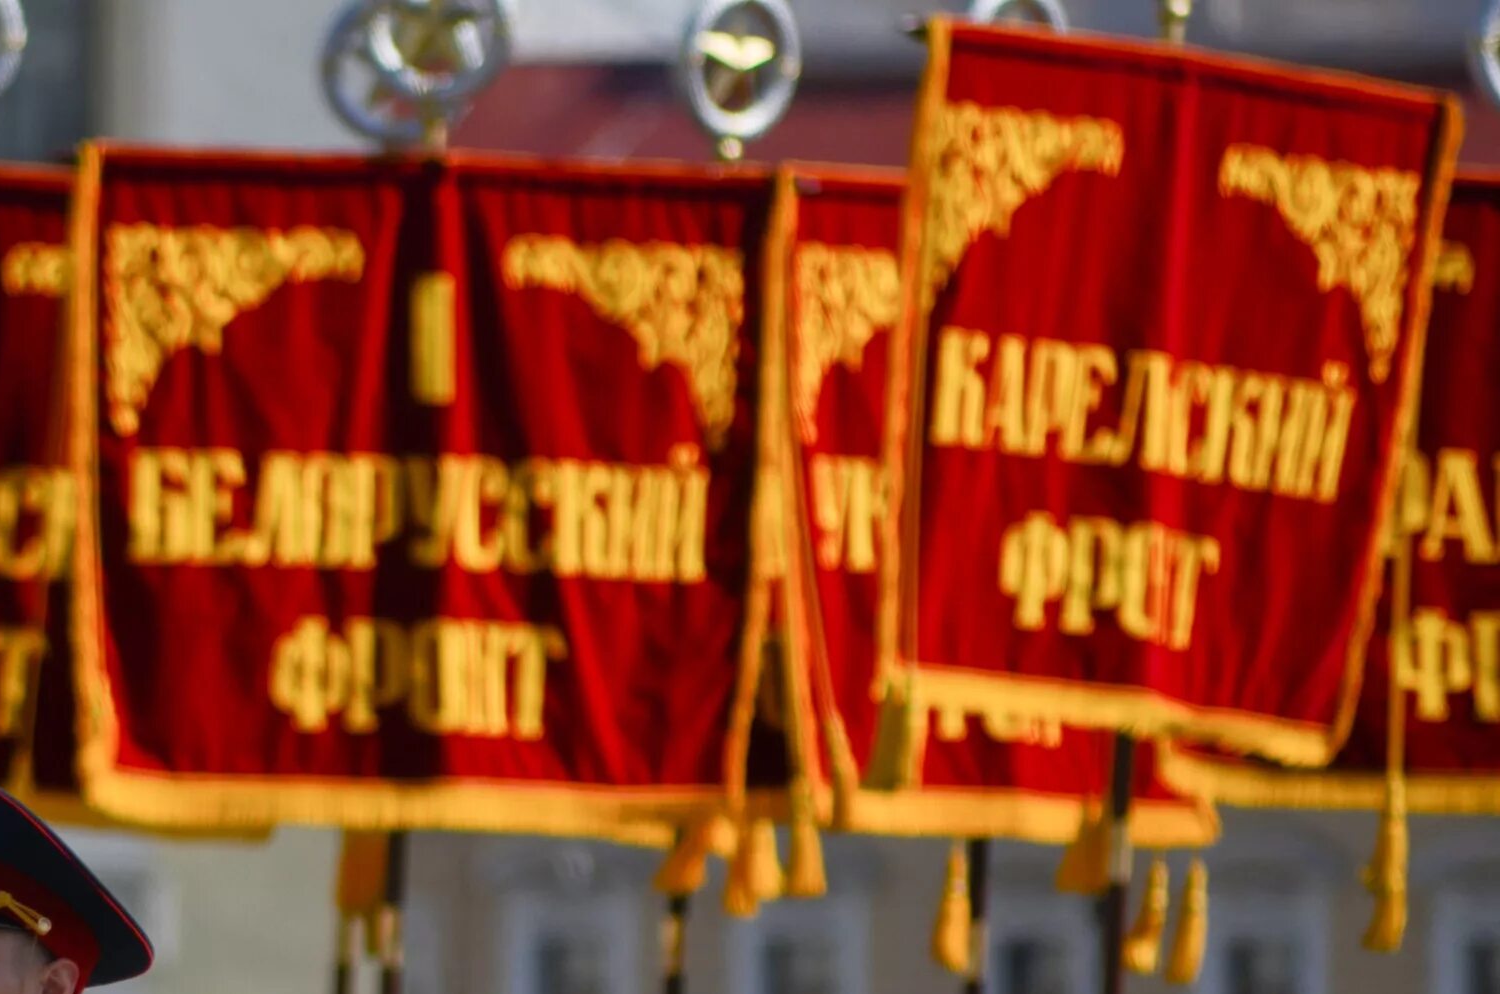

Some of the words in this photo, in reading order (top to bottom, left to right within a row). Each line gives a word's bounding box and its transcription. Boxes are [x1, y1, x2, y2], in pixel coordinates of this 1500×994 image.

[411, 272, 456, 405] 1
[127, 442, 710, 584] БЕЛОРУССКИЙ
[269, 614, 569, 741] ФРОНТ
